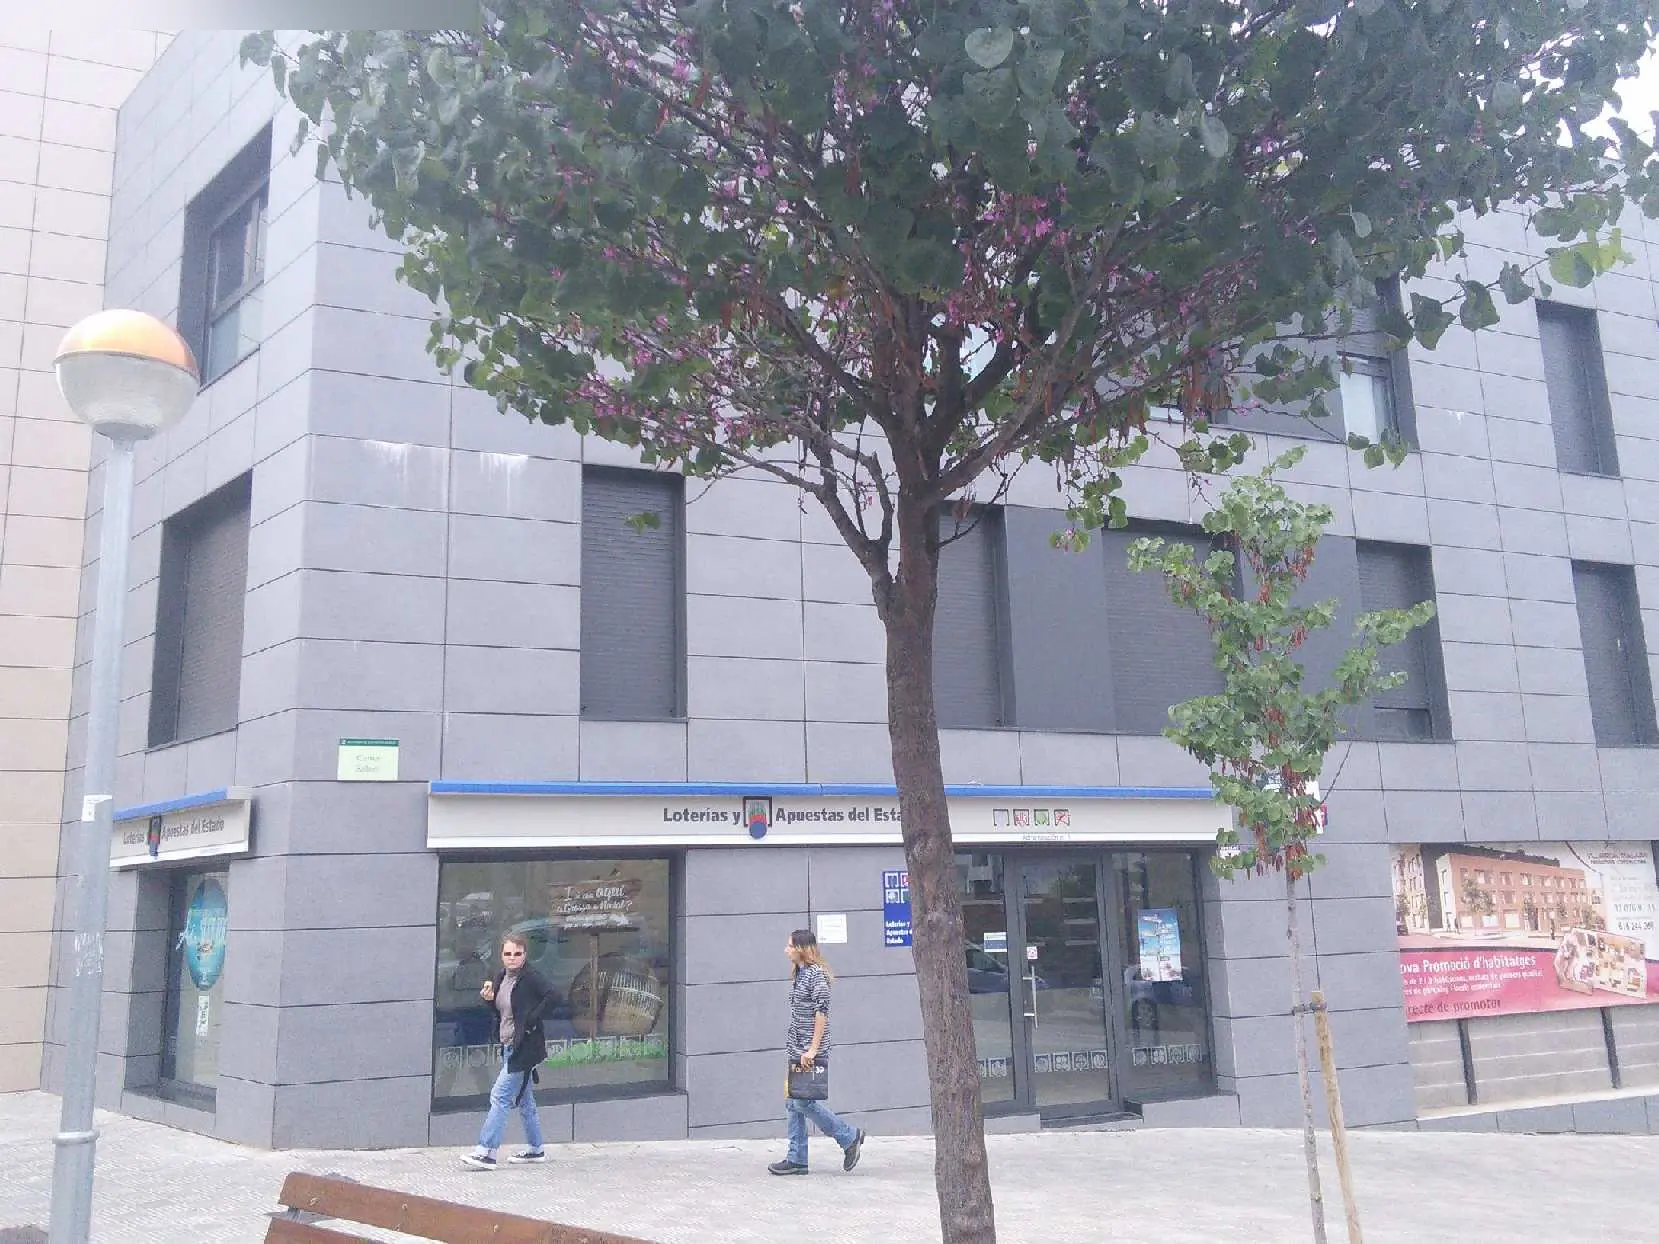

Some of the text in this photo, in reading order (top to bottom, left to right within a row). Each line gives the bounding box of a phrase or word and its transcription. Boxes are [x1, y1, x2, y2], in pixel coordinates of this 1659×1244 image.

[663, 807, 741, 825] Loterías y
[775, 807, 902, 825] Apuestas del Esta
[1400, 955, 1536, 975] ova Promoció d'habitatges
